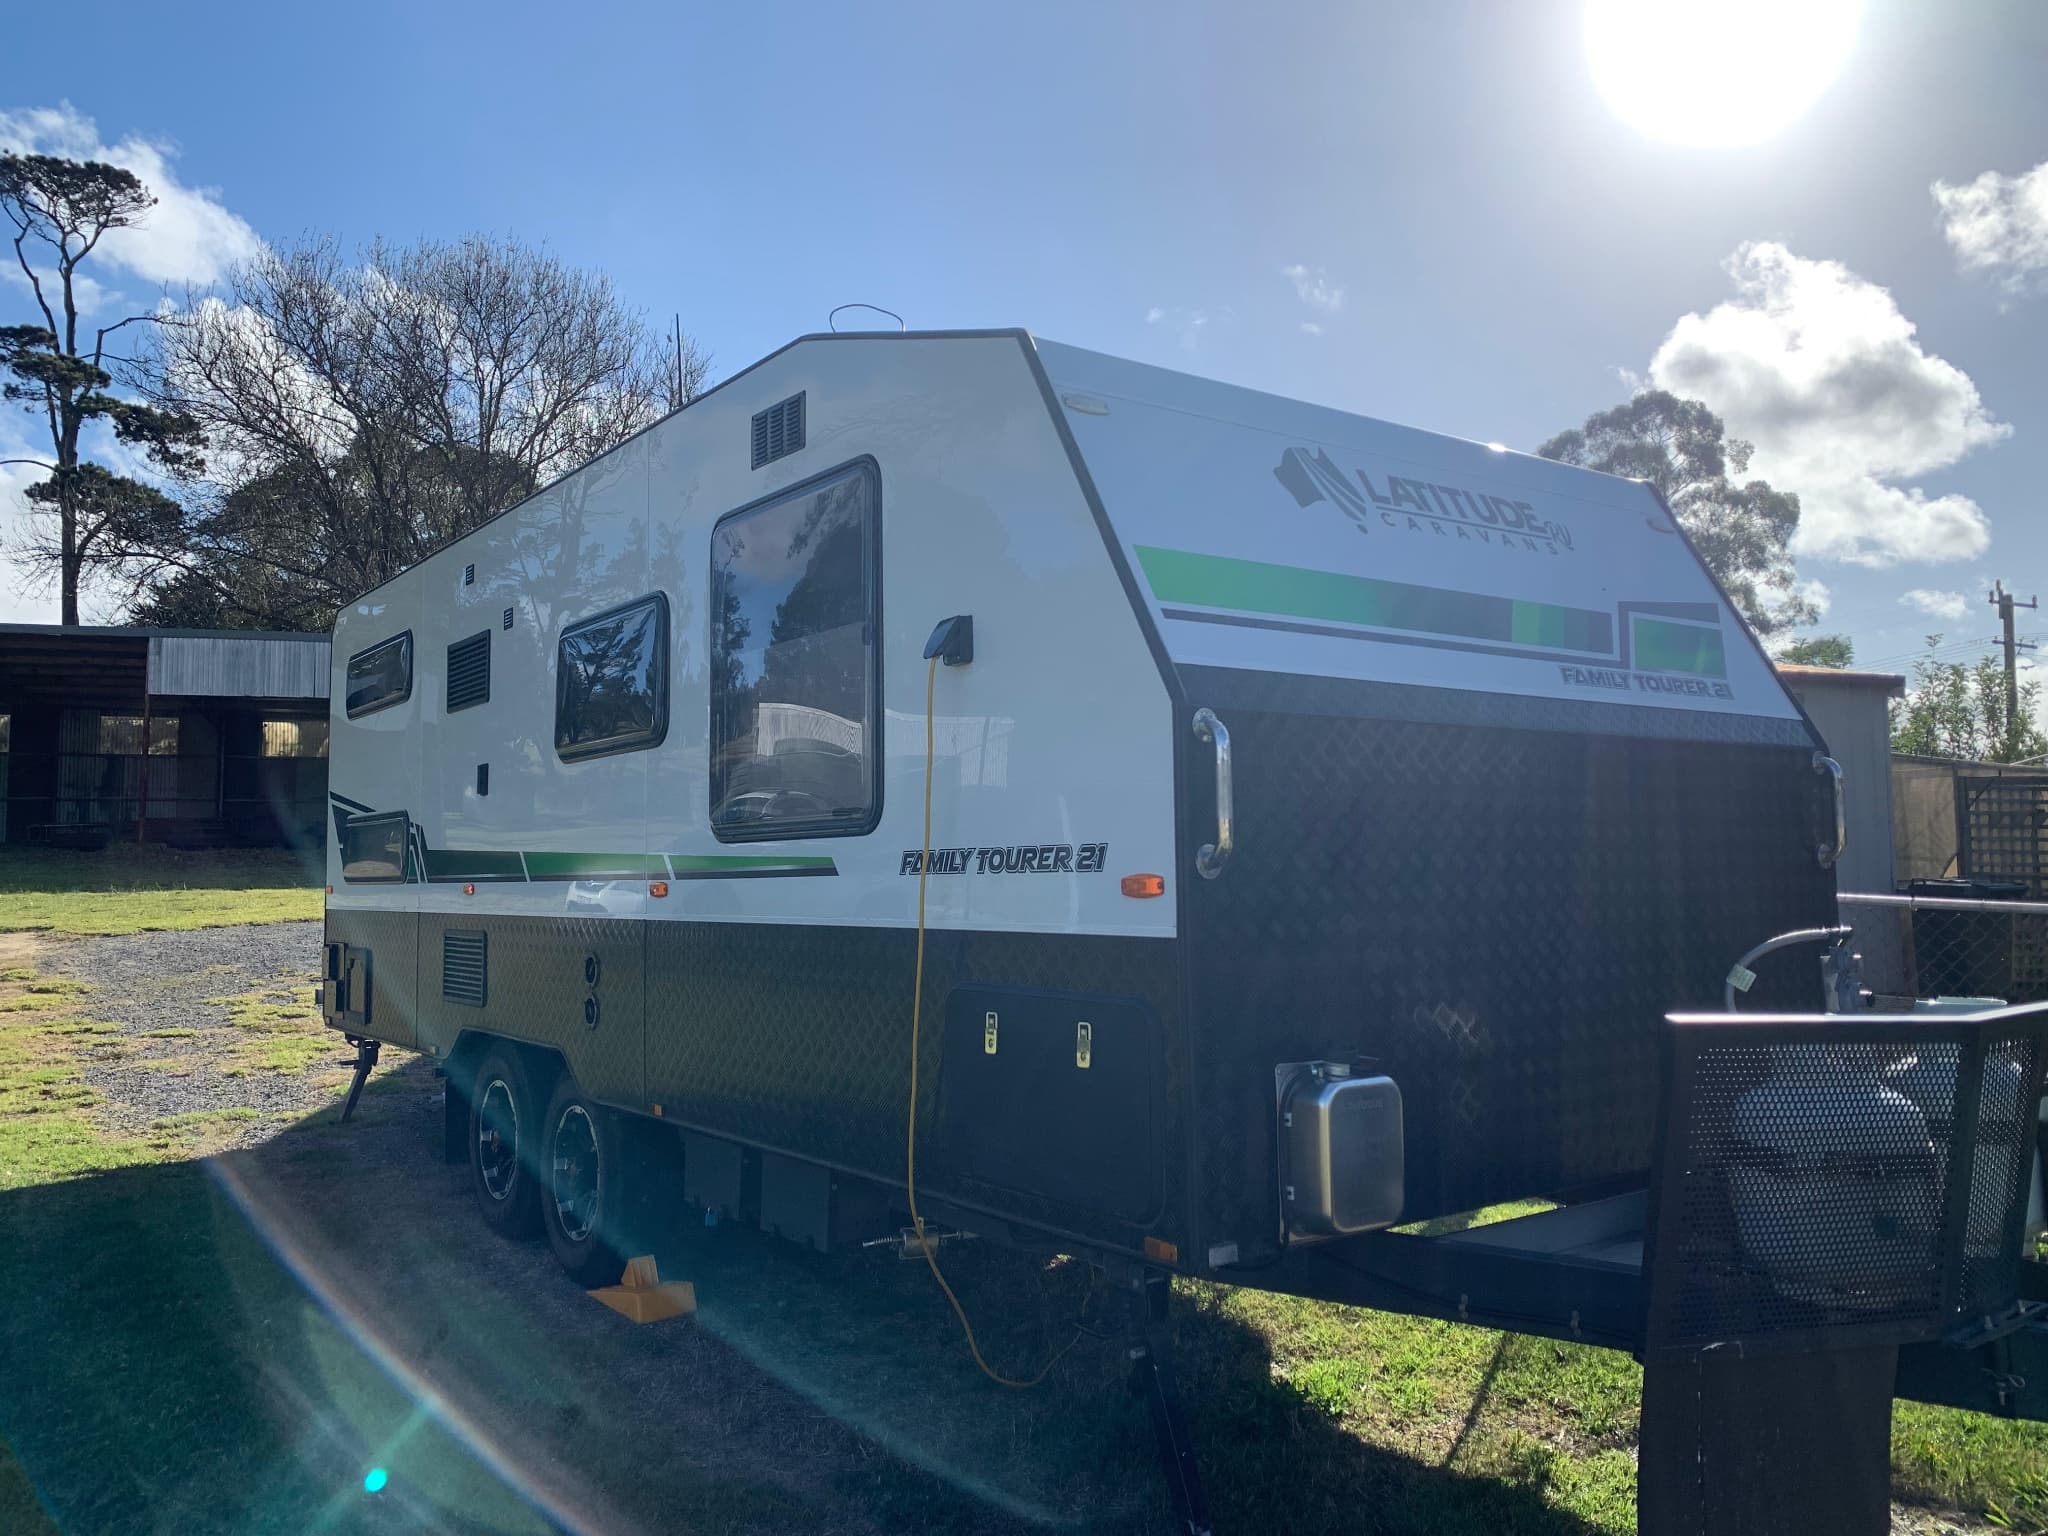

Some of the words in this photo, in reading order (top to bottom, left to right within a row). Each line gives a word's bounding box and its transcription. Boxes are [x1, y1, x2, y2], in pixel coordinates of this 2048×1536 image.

[1355, 468, 1549, 534] LATITUDE
[1380, 511, 1560, 556] CARAVANS
[1559, 666, 1632, 691] FAMILY
[1632, 672, 1712, 698] TOURER
[1711, 681, 1736, 701] 21
[976, 844, 1074, 874] TOURER
[1074, 842, 1109, 873] 21
